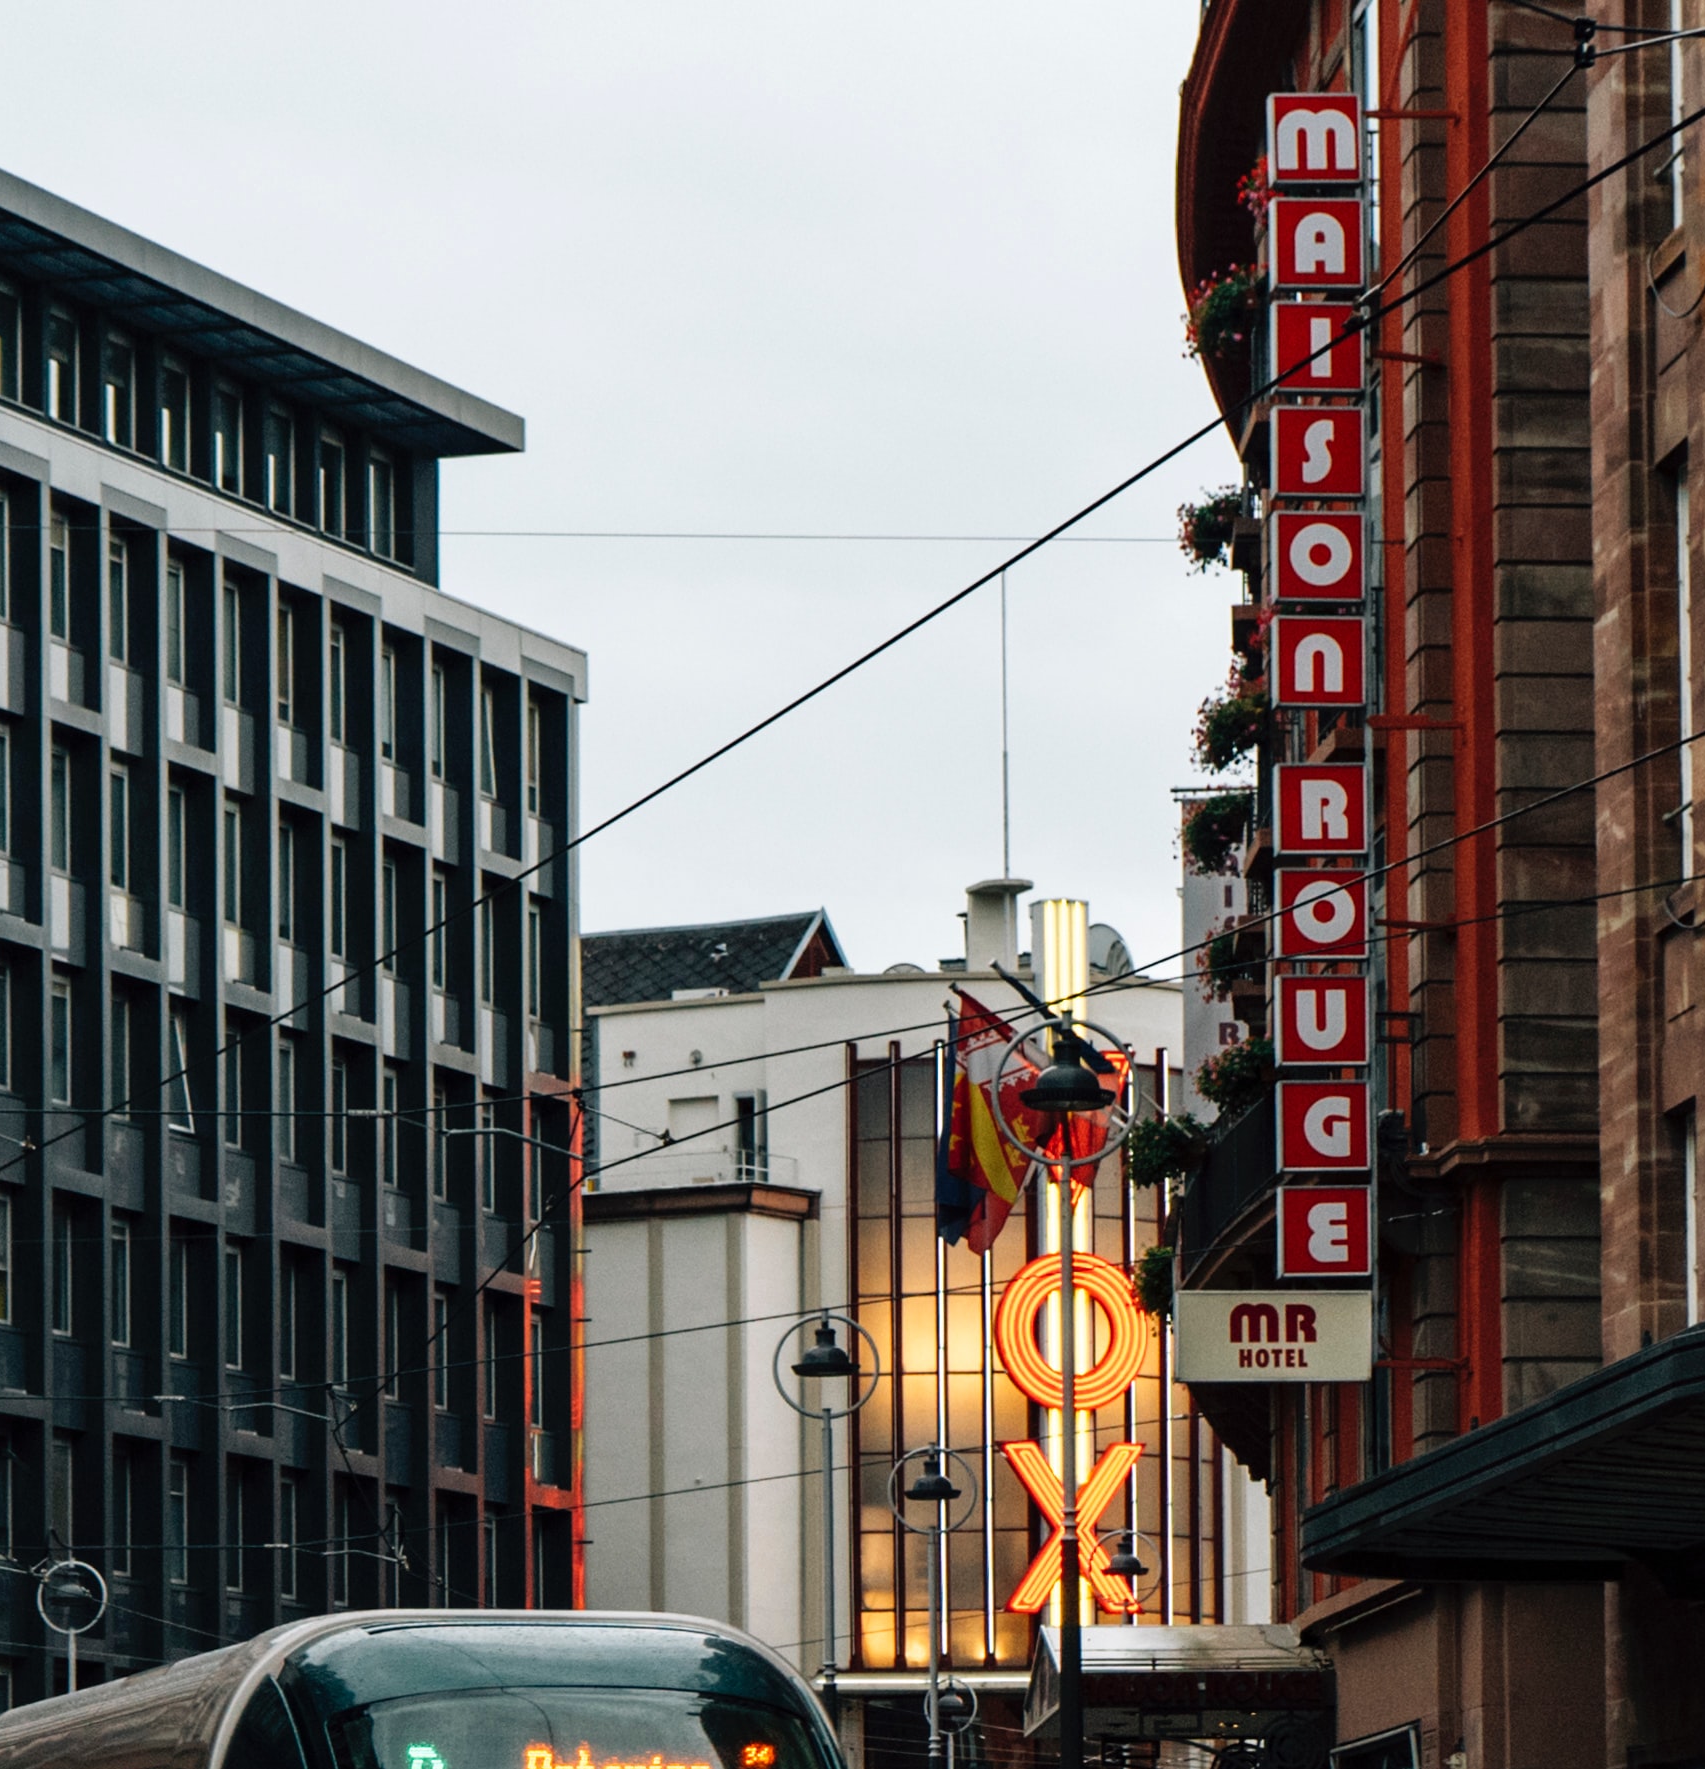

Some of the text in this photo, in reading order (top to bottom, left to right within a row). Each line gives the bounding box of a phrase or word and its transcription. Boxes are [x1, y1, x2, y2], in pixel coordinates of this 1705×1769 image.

[1276, 108, 1356, 692] MAISON
[1292, 778, 1357, 1264] ROUGE
[1238, 1348, 1309, 1369] HOTEL
